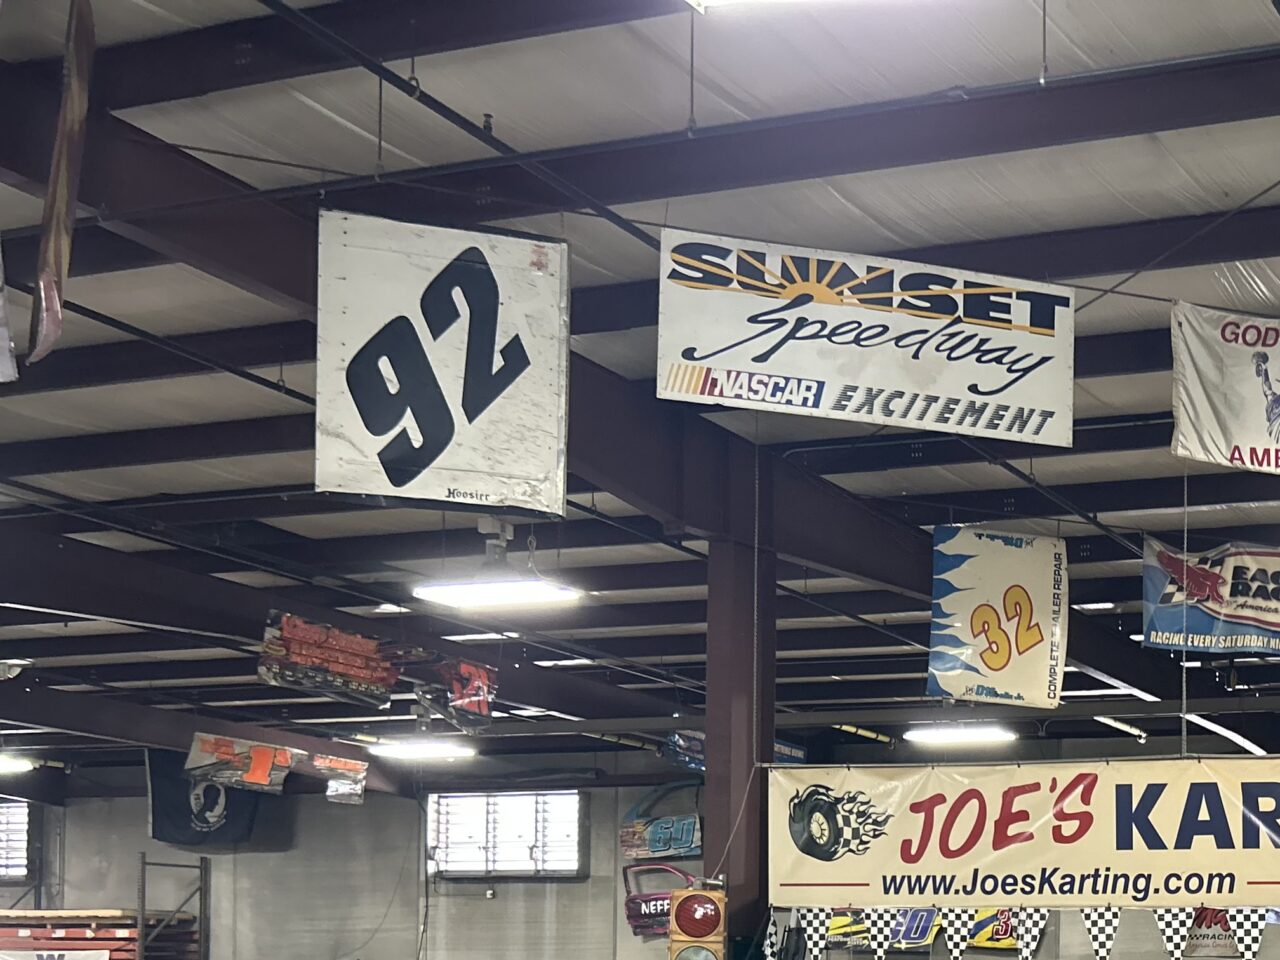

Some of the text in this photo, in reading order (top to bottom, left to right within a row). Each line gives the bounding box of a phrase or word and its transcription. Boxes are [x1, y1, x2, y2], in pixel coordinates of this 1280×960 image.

[667, 242, 1070, 337] SUNSET
[346, 246, 530, 488] 92
[681, 293, 1055, 395] Speedway
[1221, 320, 1280, 349] GOD
[711, 369, 1055, 435] NASCAR EXCITEMENT
[970, 584, 1044, 671] 32
[1047, 552, 1063, 699] COMPLETE TAILER REPAIR
[1150, 630, 1186, 646] RACING
[1187, 633, 1217, 648] EVERY
[1218, 635, 1268, 649] SATURDAY
[651, 814, 696, 852] 60
[899, 771, 1098, 865] JOE'S
[641, 900, 671, 914] NEFF
[880, 867, 1236, 904] www.JoesKarting.com
[1202, 933, 1235, 941] RACIN
